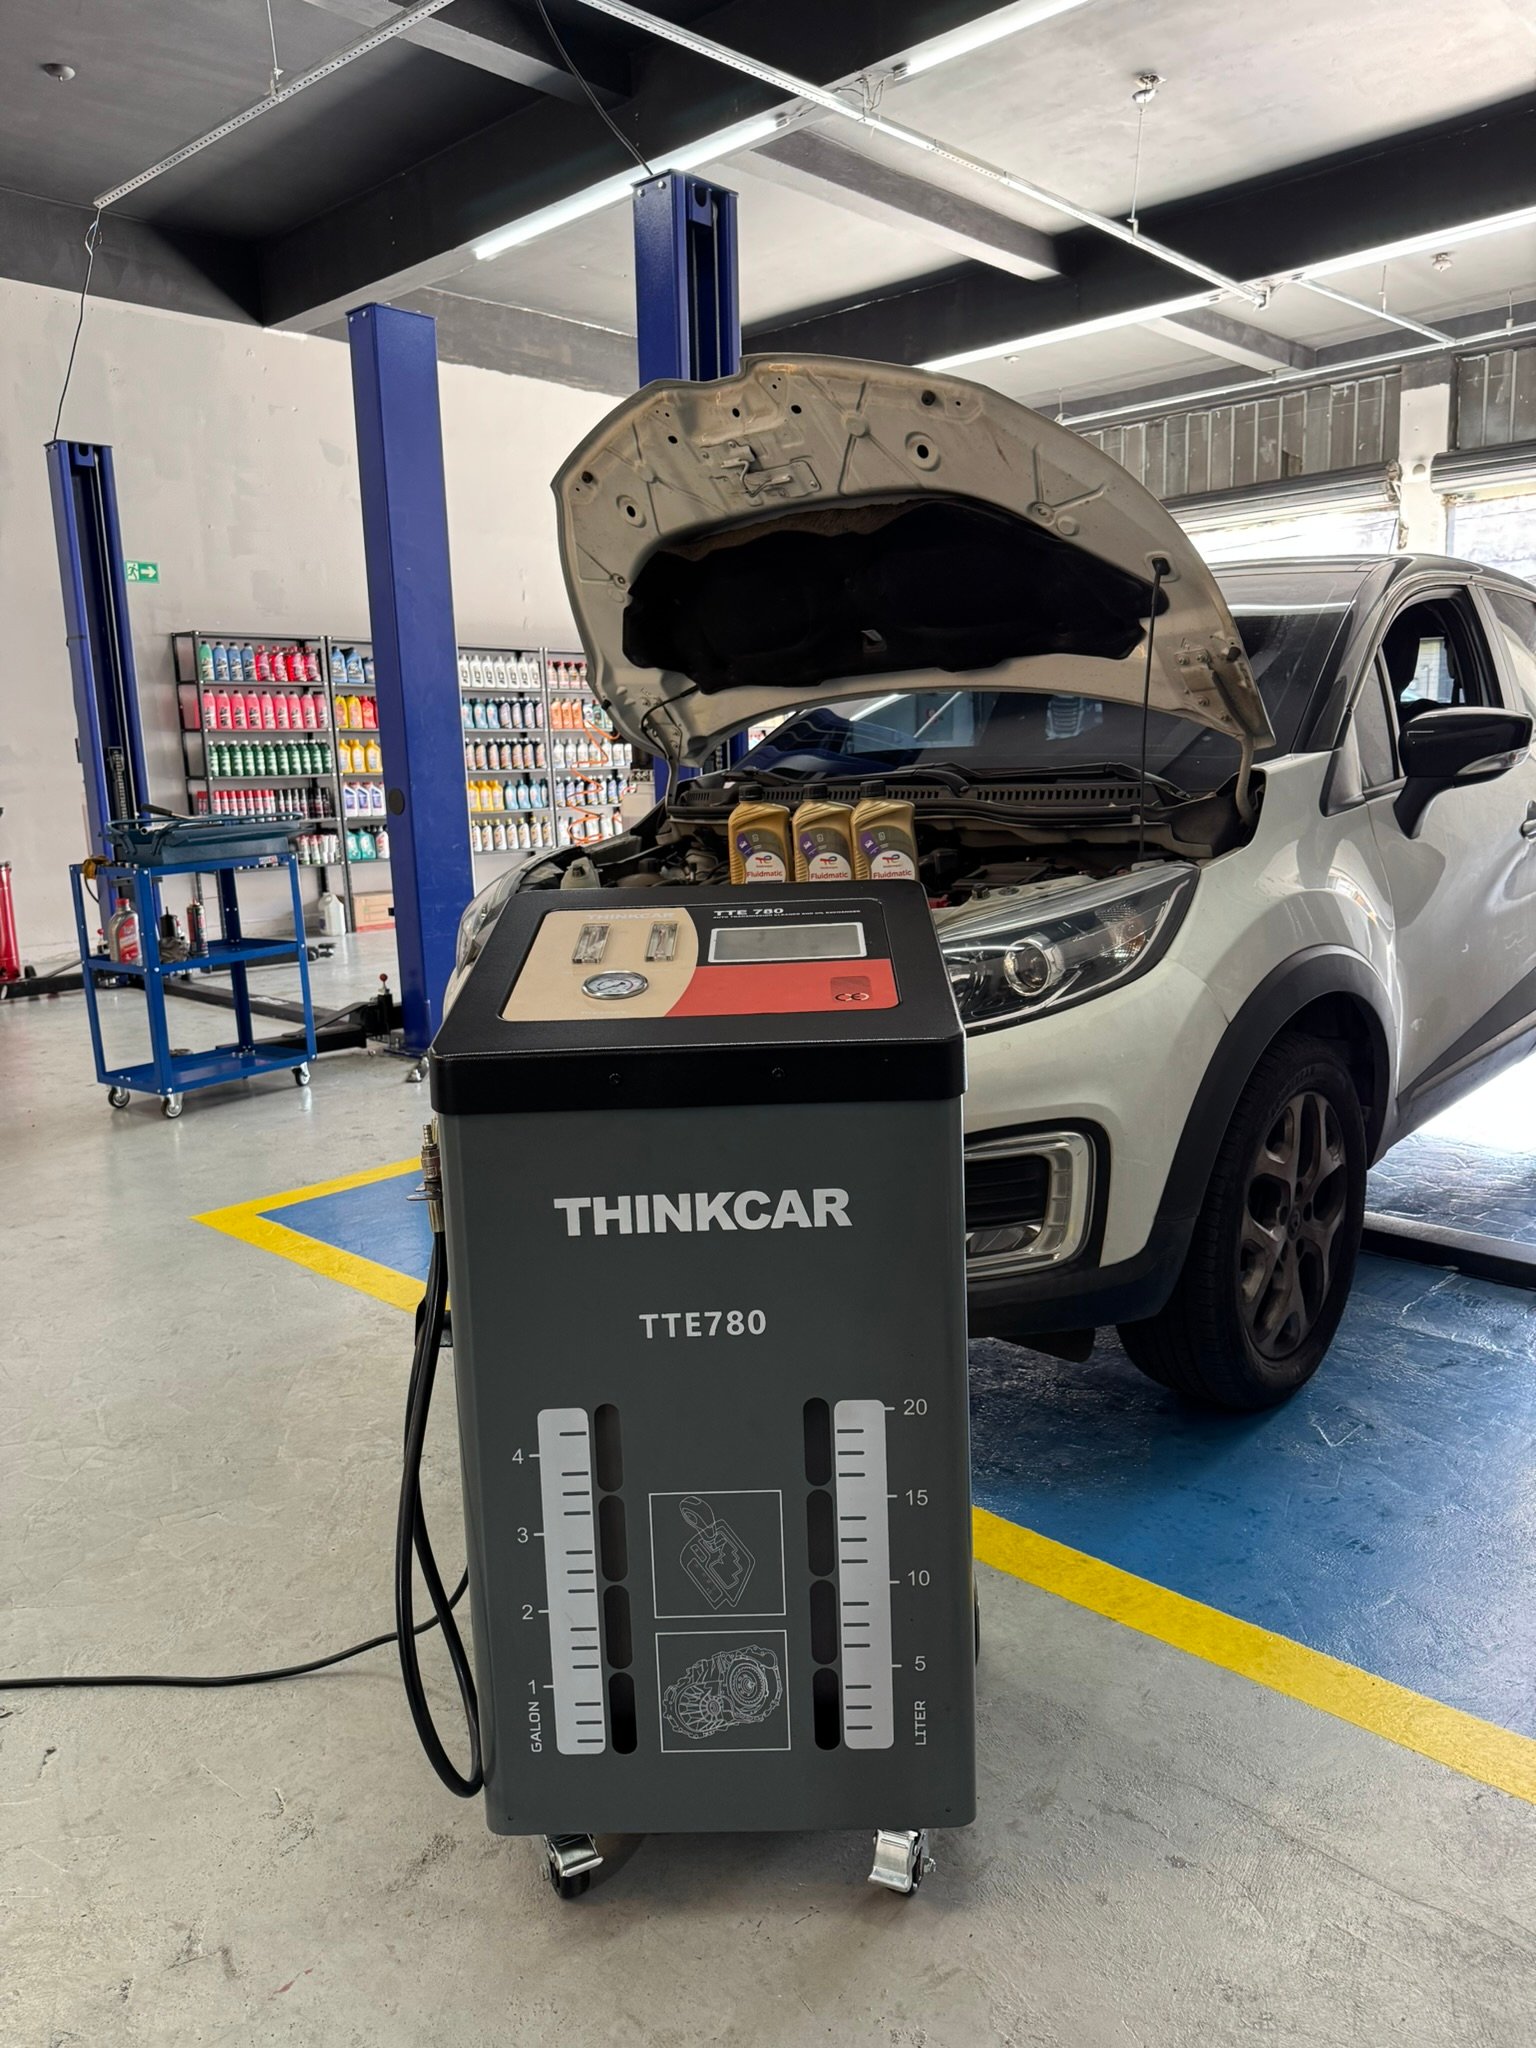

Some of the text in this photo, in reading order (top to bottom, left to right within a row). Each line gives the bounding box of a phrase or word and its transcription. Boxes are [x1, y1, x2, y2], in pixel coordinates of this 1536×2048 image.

[746, 870, 783, 878] Fluidmatic
[811, 872, 848, 880] Fluidmatic
[873, 870, 912, 879] Fluidmatic
[586, 911, 675, 921] THINKCAR
[713, 907, 784, 917] TTE 780
[553, 1188, 853, 1237] THINKCAR
[638, 1309, 767, 1339] TTE780
[903, 1399, 928, 1416] 20
[511, 1448, 524, 1464] 4
[904, 1489, 929, 1506] 15
[517, 1527, 529, 1543] 3
[907, 1570, 930, 1587] 10
[521, 1604, 534, 1620] 2
[914, 1655, 926, 1672] 5
[527, 1679, 536, 1695] 1
[527, 1701, 543, 1753] GALON
[914, 1700, 927, 1746] LITER
